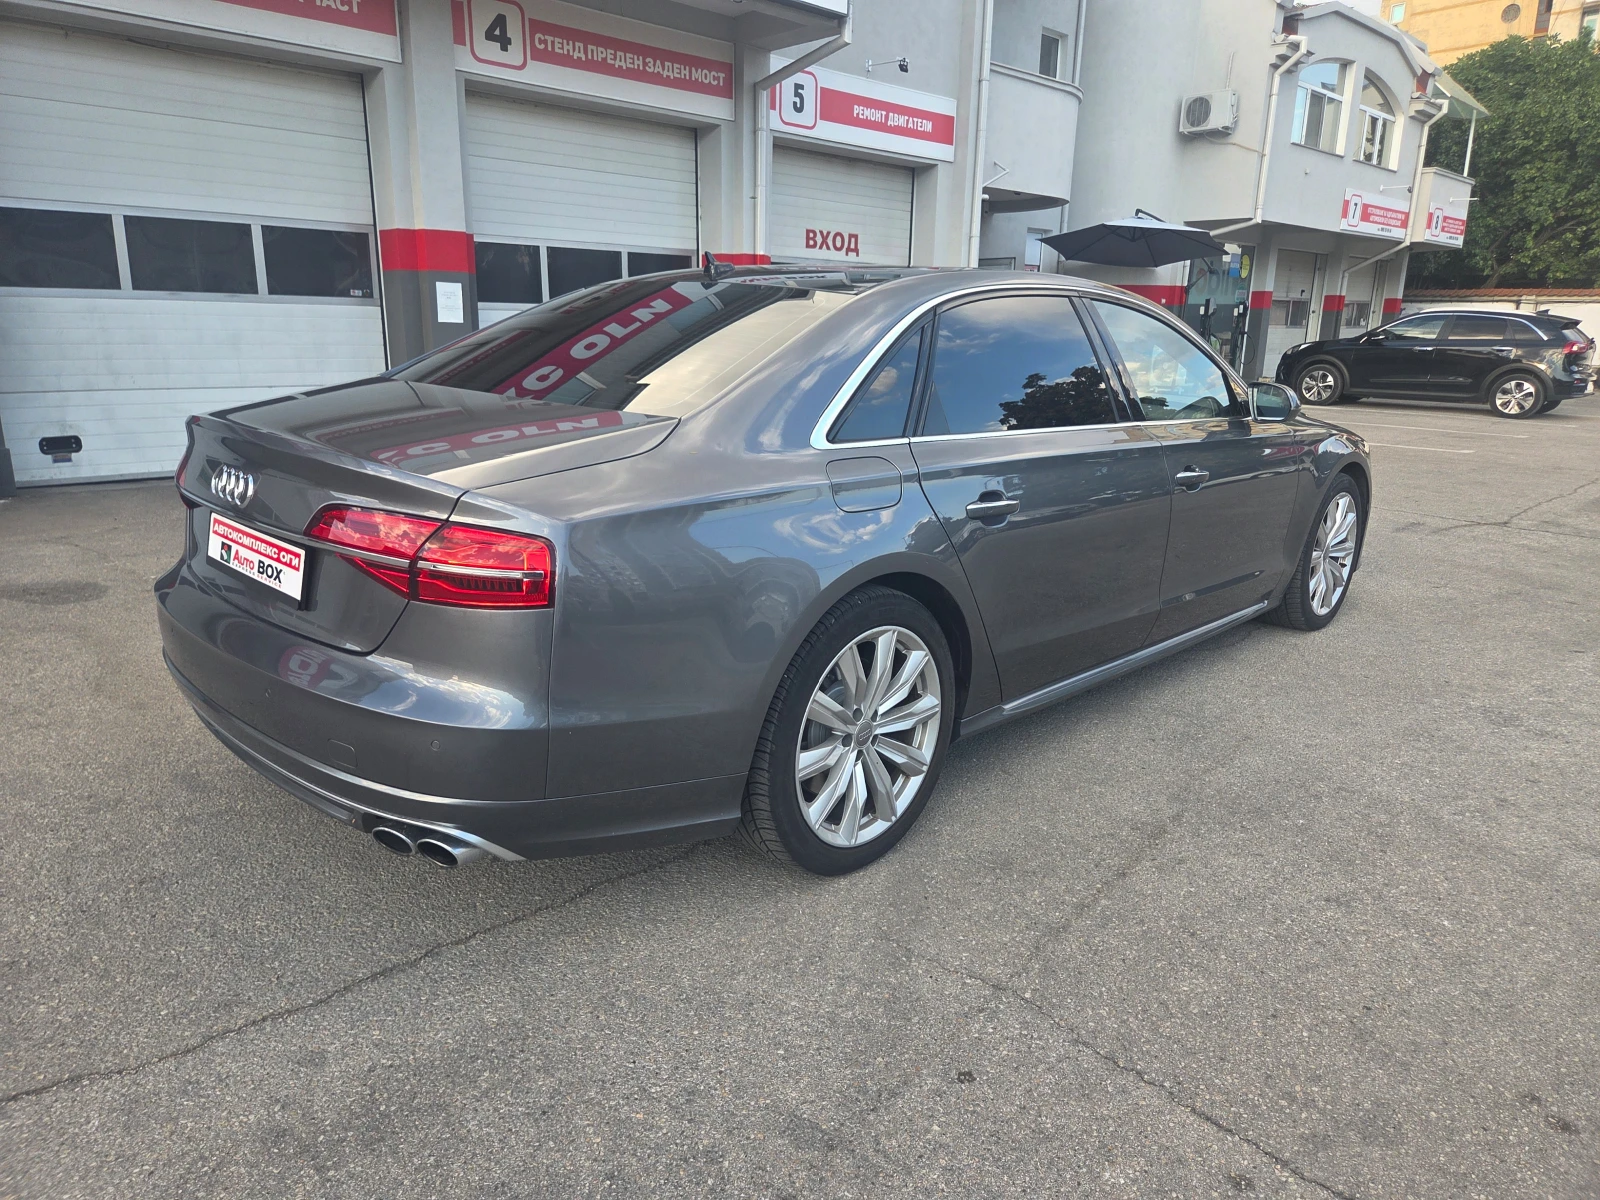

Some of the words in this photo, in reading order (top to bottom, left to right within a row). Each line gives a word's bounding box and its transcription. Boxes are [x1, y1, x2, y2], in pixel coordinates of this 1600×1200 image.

[485, 13, 512, 52] 4
[534, 33, 586, 61] СТЕНД
[588, 45, 643, 70] ПРЕДЕН
[645, 57, 690, 80] ЗАДЕН
[691, 68, 726, 87] МОСТ
[792, 83, 805, 114] 5
[853, 105, 886, 123] РЕМОНТ
[887, 113, 933, 133] ДВИГАТЕЛИ
[1353, 203, 1358, 219] 7
[805, 228, 860, 257] ВХОД
[213, 523, 279, 558] АВТОКОМПЛЕКС
[280, 551, 300, 568] ОГИ
[256, 574, 283, 589] SERVICE
[257, 559, 284, 584] BOX
